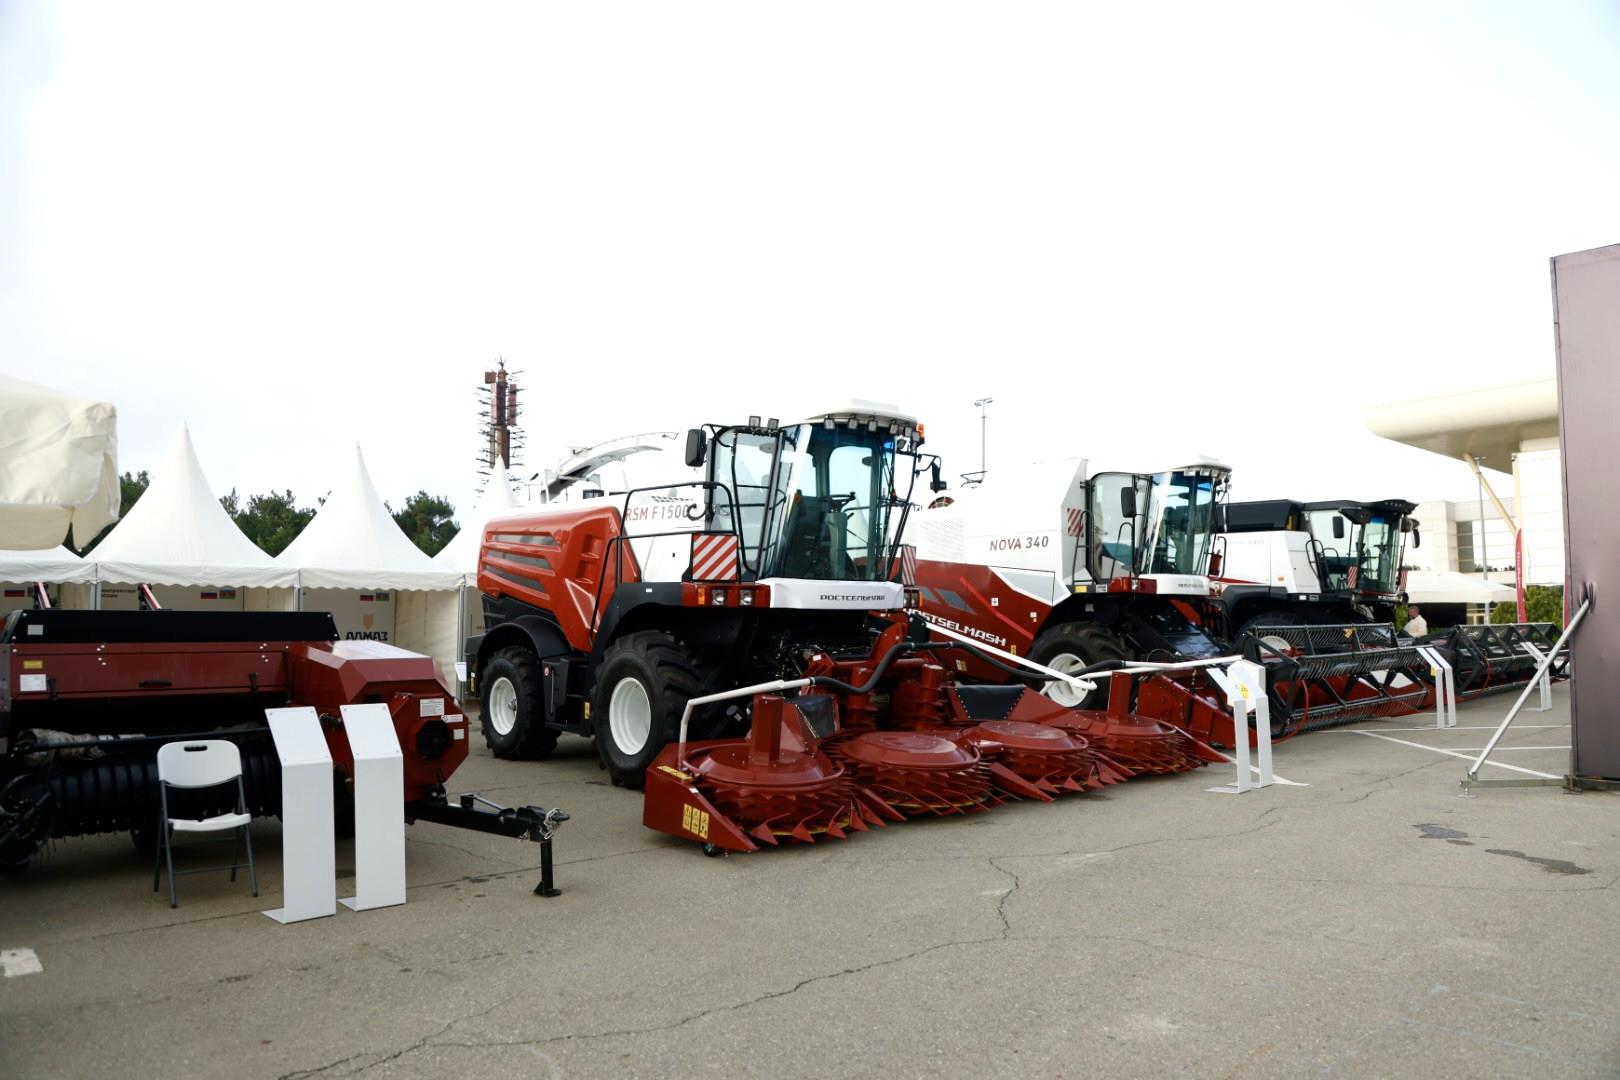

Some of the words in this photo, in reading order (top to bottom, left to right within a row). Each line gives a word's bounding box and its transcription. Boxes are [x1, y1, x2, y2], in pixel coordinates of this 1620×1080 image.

[625, 506, 649, 521] RSM
[652, 506, 658, 520] F
[661, 504, 689, 519] 1500
[989, 538, 1022, 551] NOVA
[1025, 535, 1049, 549] 340
[345, 631, 388, 641] АЛМАЗ
